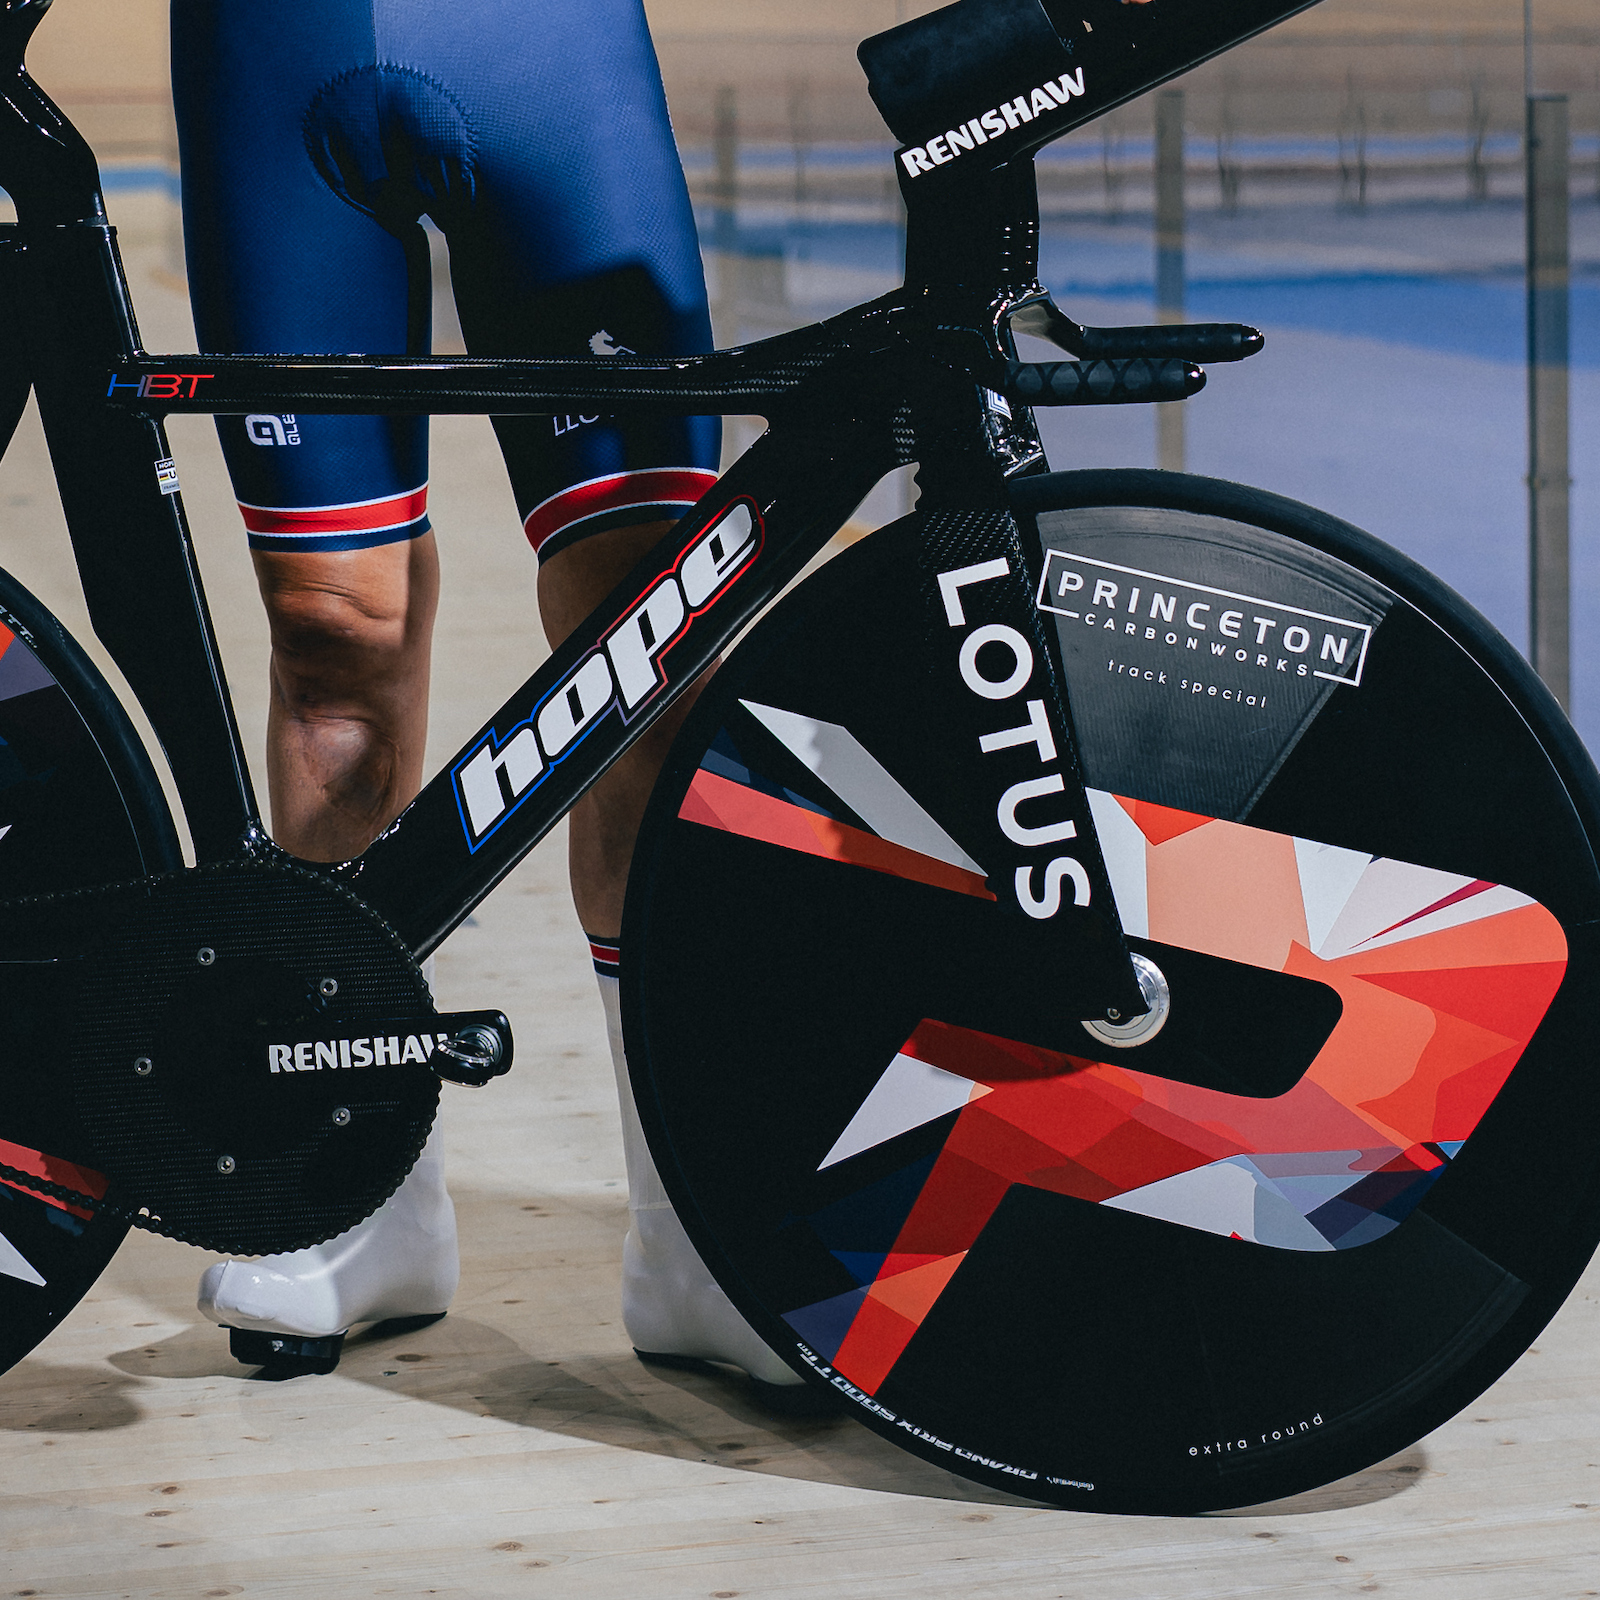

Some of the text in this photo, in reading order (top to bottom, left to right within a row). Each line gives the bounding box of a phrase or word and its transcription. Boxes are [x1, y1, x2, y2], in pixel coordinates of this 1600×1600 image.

[901, 66, 1086, 178] RENISHAW
[1057, 570, 1349, 664] PRINCETON
[1084, 612, 1308, 677] CARBONWORKS
[460, 503, 756, 837] hope
[1107, 659, 1267, 708] track special
[936, 557, 1092, 919] LOTUS
[1188, 1412, 1324, 1456] extra round
